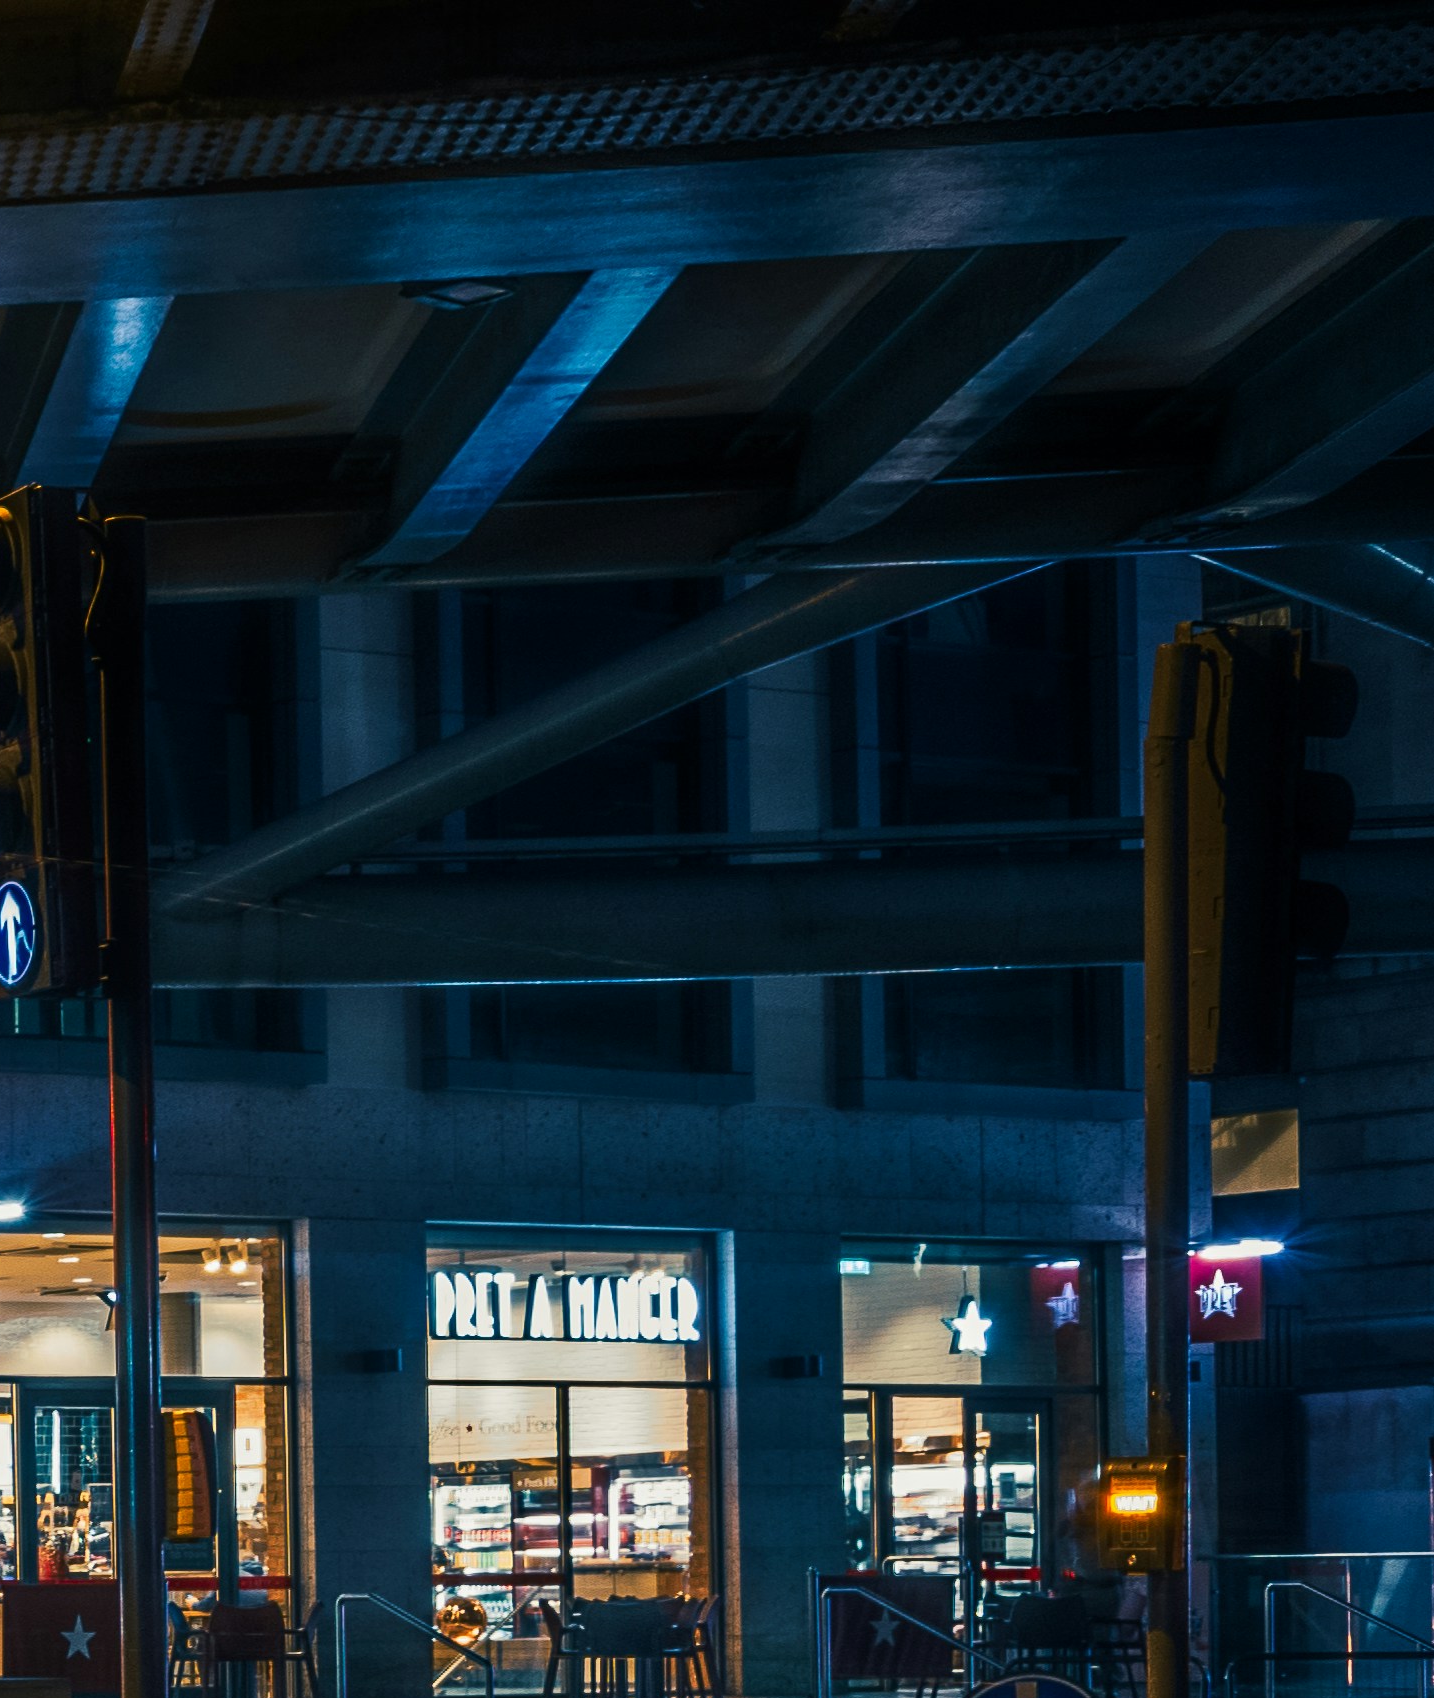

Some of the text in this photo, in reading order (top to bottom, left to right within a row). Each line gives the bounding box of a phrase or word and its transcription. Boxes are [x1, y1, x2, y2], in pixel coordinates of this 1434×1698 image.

[435, 1271, 700, 1341] PRET A MANGER
[526, 1415, 556, 1433] Foo
